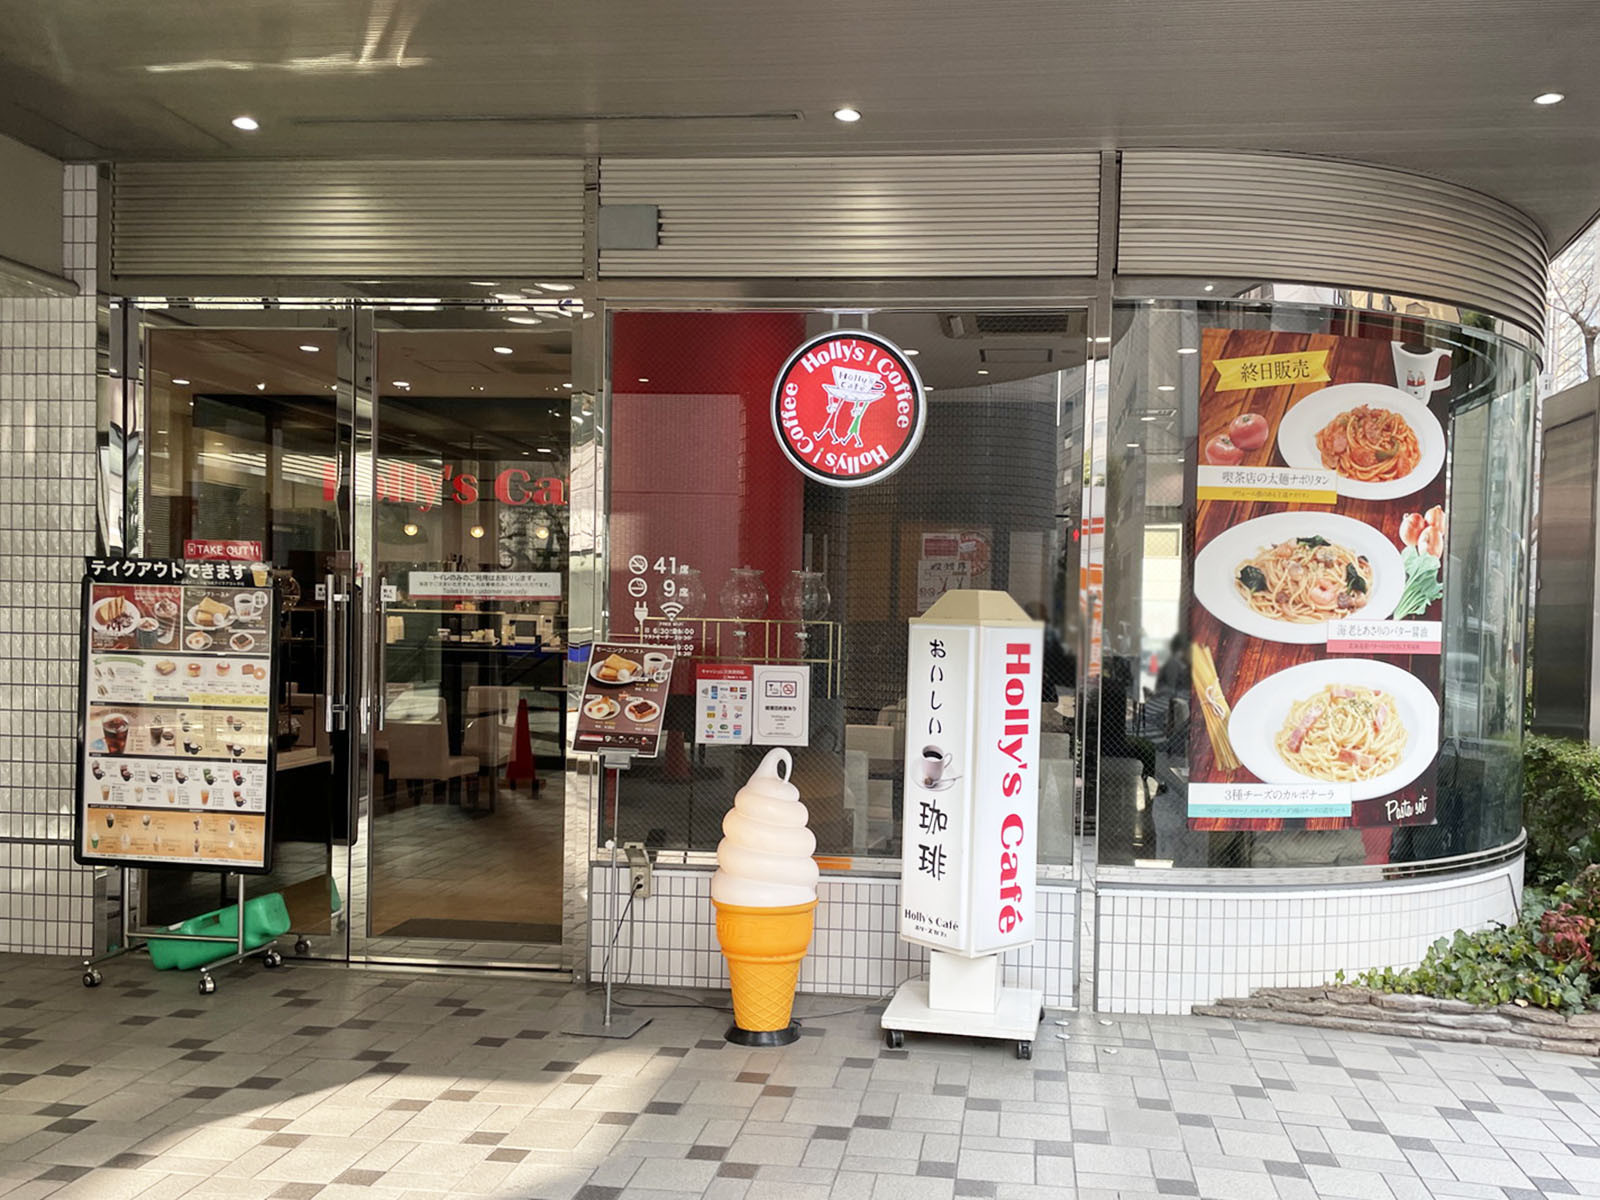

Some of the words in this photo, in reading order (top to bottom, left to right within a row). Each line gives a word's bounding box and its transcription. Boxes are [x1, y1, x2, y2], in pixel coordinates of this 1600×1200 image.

[1240, 359, 1310, 383] 終日販売
[876, 358, 913, 428] Coffee
[781, 382, 814, 453] Coffee
[323, 464, 478, 512] lly's
[1222, 471, 1328, 486] 喫茶店の太麺ナポリタン
[197, 544, 224, 556] TAKE
[91, 560, 247, 580] テイクアウトできます
[596, 646, 646, 655] モーニングトースト
[929, 639, 947, 737] おいしい
[997, 643, 1031, 797] Holly's
[1224, 789, 1335, 801] 3種チーズのカルボナーラ
[1385, 799, 1414, 822] Pasta
[1415, 795, 1429, 815] set
[918, 799, 949, 882] 珈琲
[998, 813, 1024, 934] Café
